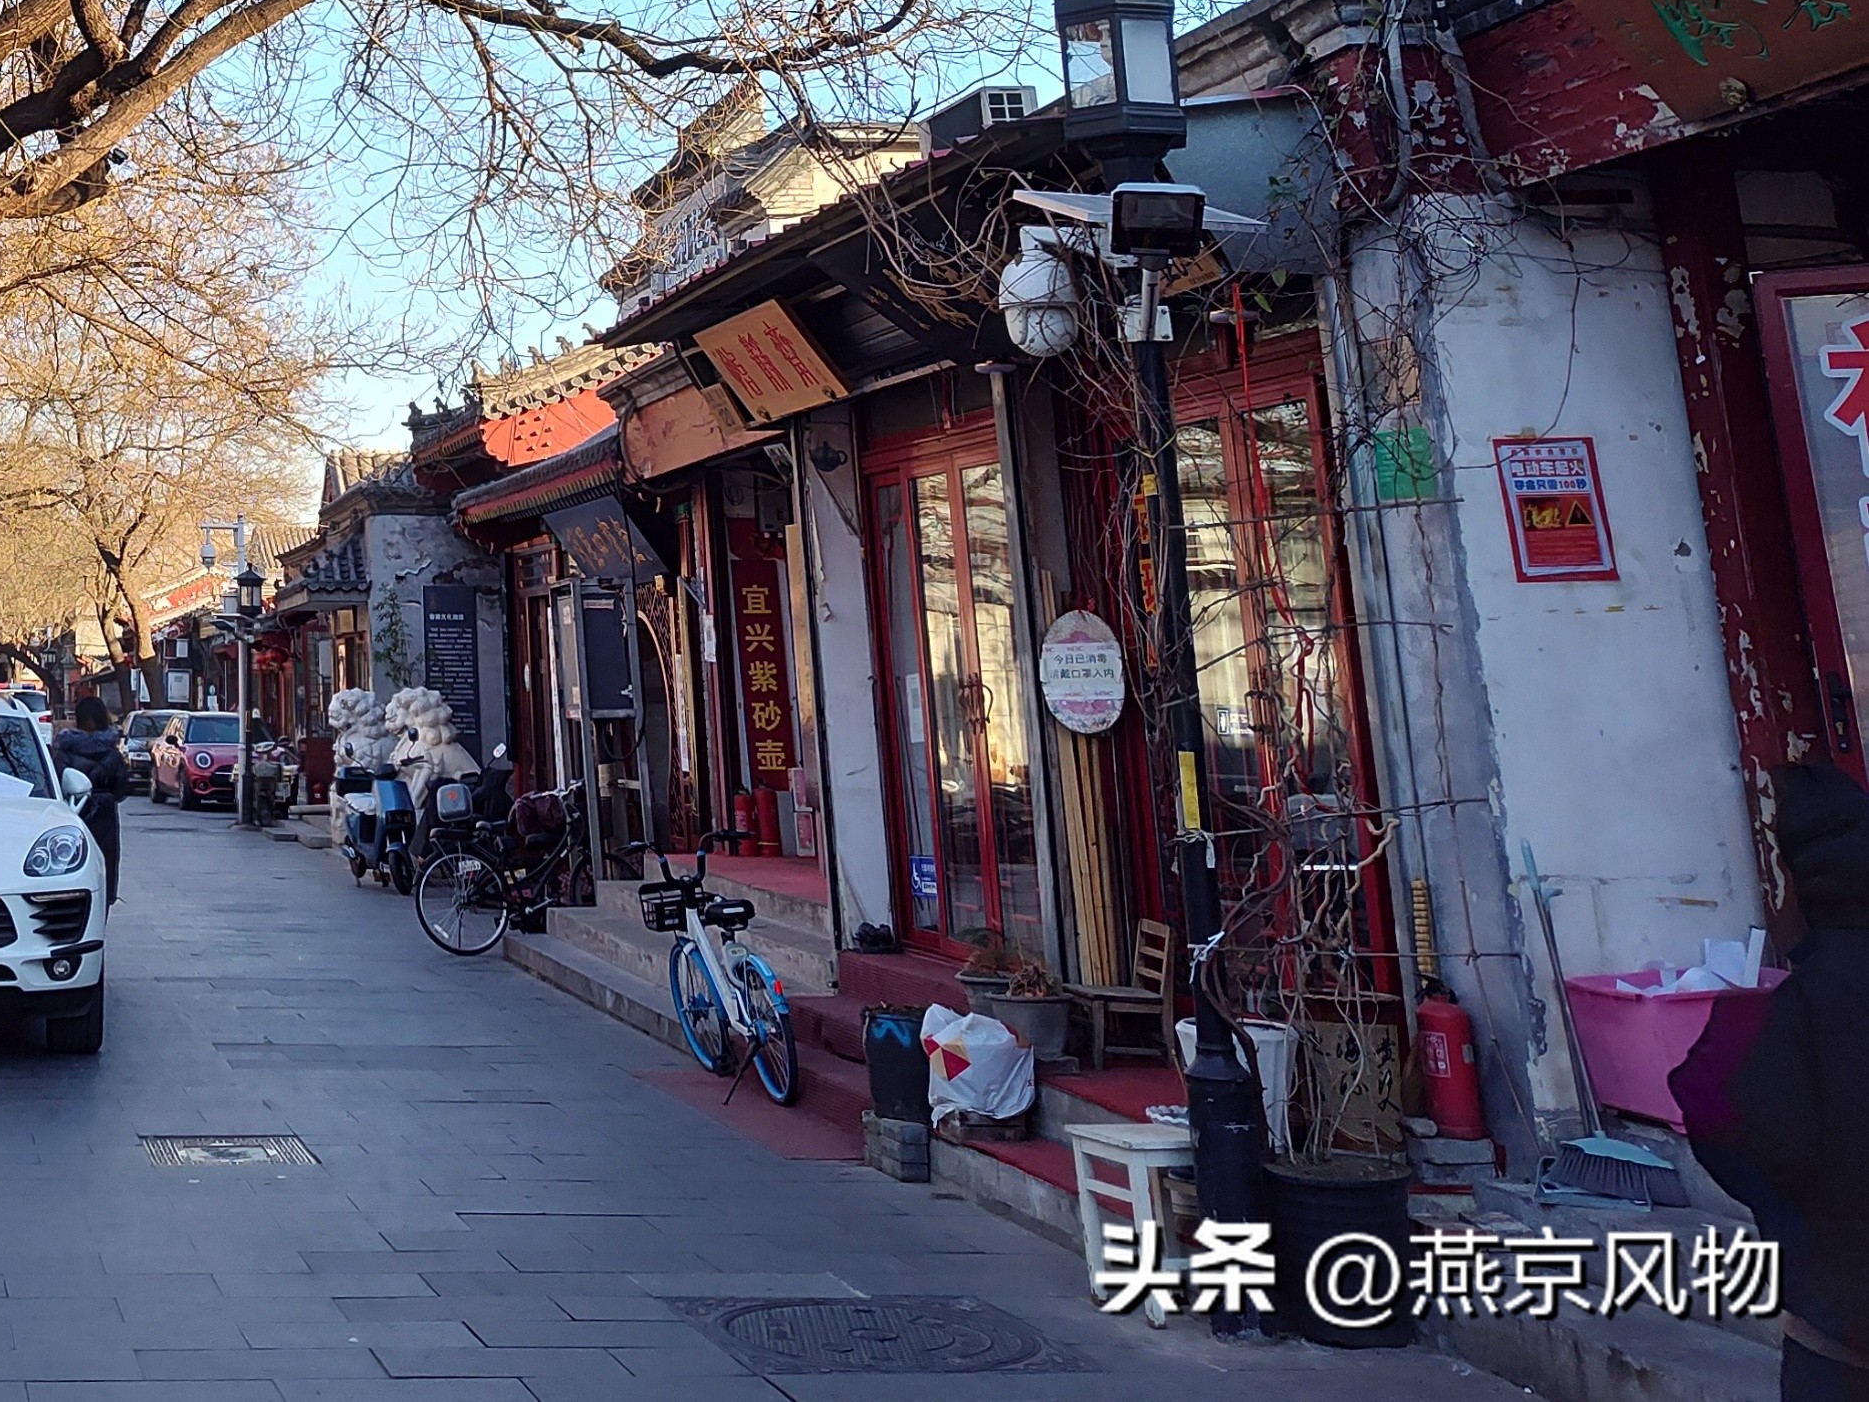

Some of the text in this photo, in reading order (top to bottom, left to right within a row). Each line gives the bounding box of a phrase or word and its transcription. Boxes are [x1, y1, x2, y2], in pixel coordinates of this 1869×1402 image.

[1511, 460, 1585, 476] 电动车起火
[1053, 654, 1107, 664] 今日已消毒
[741, 584, 787, 771] 宜兴紫砂壶
